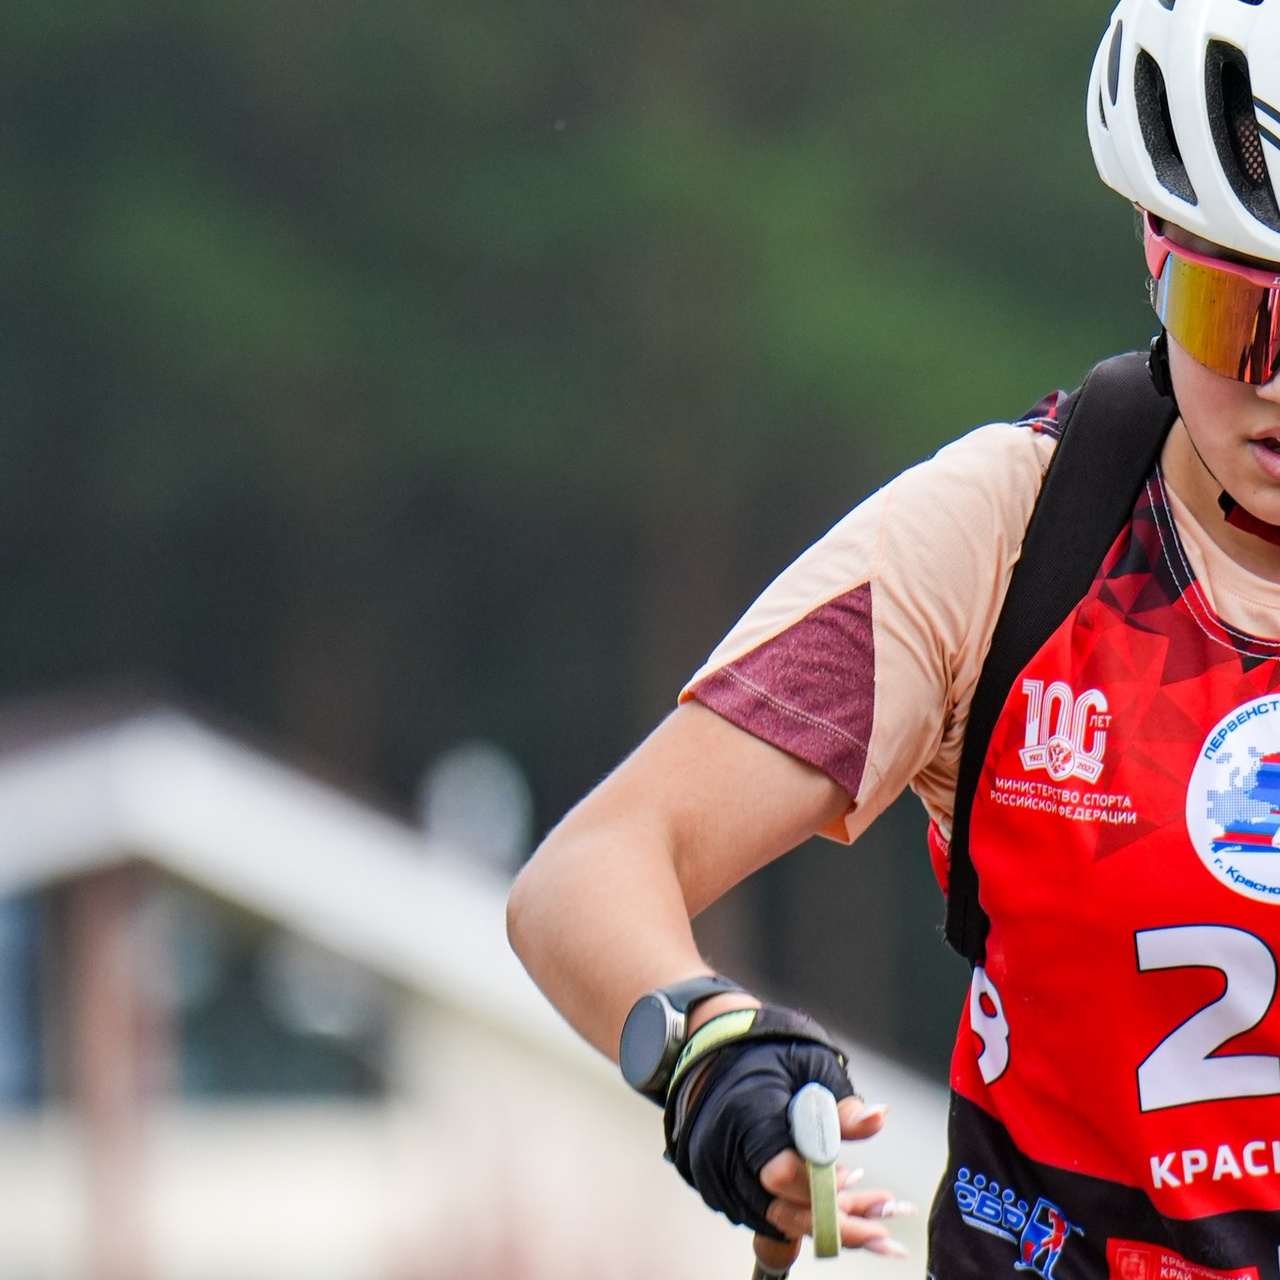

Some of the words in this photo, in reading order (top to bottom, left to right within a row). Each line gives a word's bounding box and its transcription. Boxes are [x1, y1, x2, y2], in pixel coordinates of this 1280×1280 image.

[1022, 678, 1108, 760] 100
[1089, 714, 1112, 728] ЛЕТ
[990, 789, 1058, 814] РОССИЙСКОЙ
[1058, 805, 1137, 825] ФЕДЕРАЦИИ
[995, 777, 1079, 804] МИНИСТЕРСТВО
[1083, 793, 1132, 809] СПОРТА
[953, 1180, 1027, 1232] СБР
